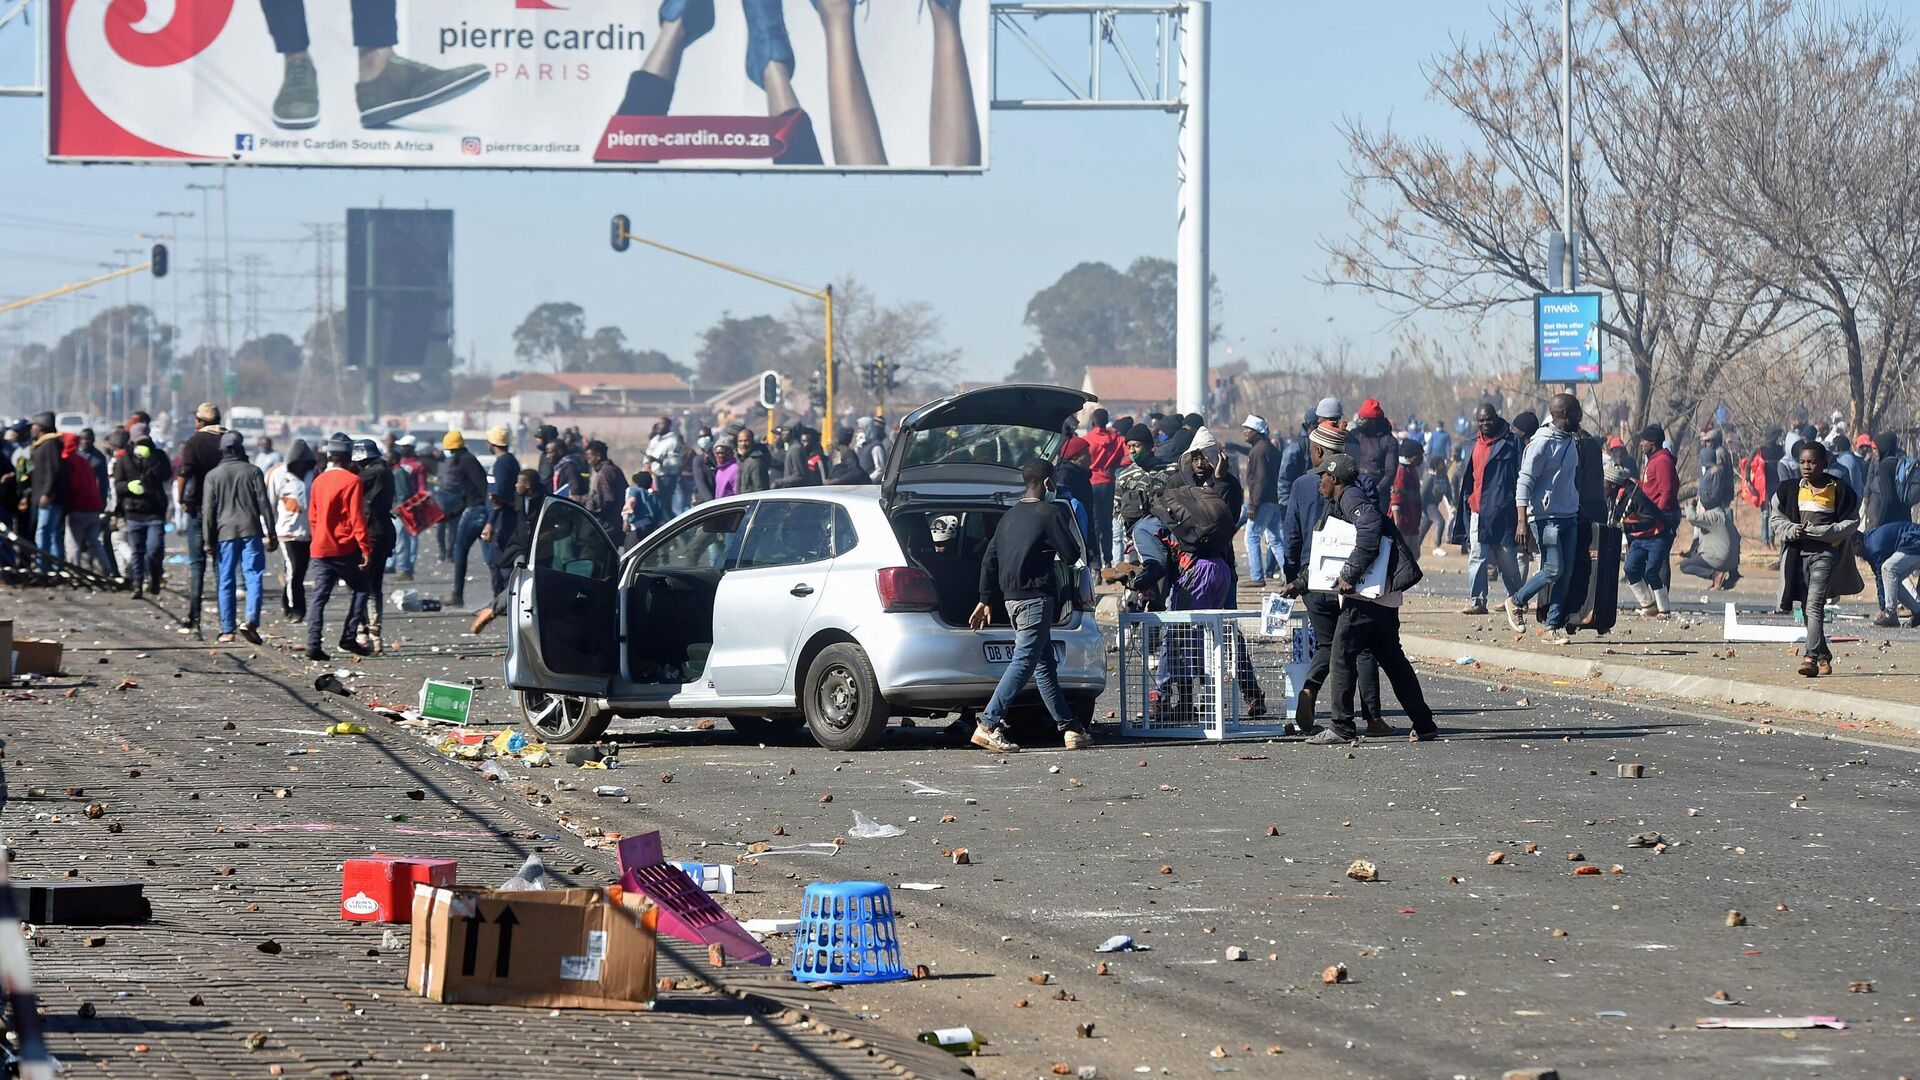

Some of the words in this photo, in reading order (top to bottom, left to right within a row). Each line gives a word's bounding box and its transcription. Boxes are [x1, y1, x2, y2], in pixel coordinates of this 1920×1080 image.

[440, 21, 534, 54] pierre
[544, 24, 645, 50] cardin
[495, 63, 590, 80] PARIS
[259, 137, 299, 149] Pierre
[303, 138, 347, 150] Cardin
[352, 139, 390, 150] South
[395, 140, 433, 152] Africa
[608, 130, 770, 148] pierre-cardin.co.za
[486, 142, 580, 154] pierrecardinza
[987, 646, 1002, 660] DB
